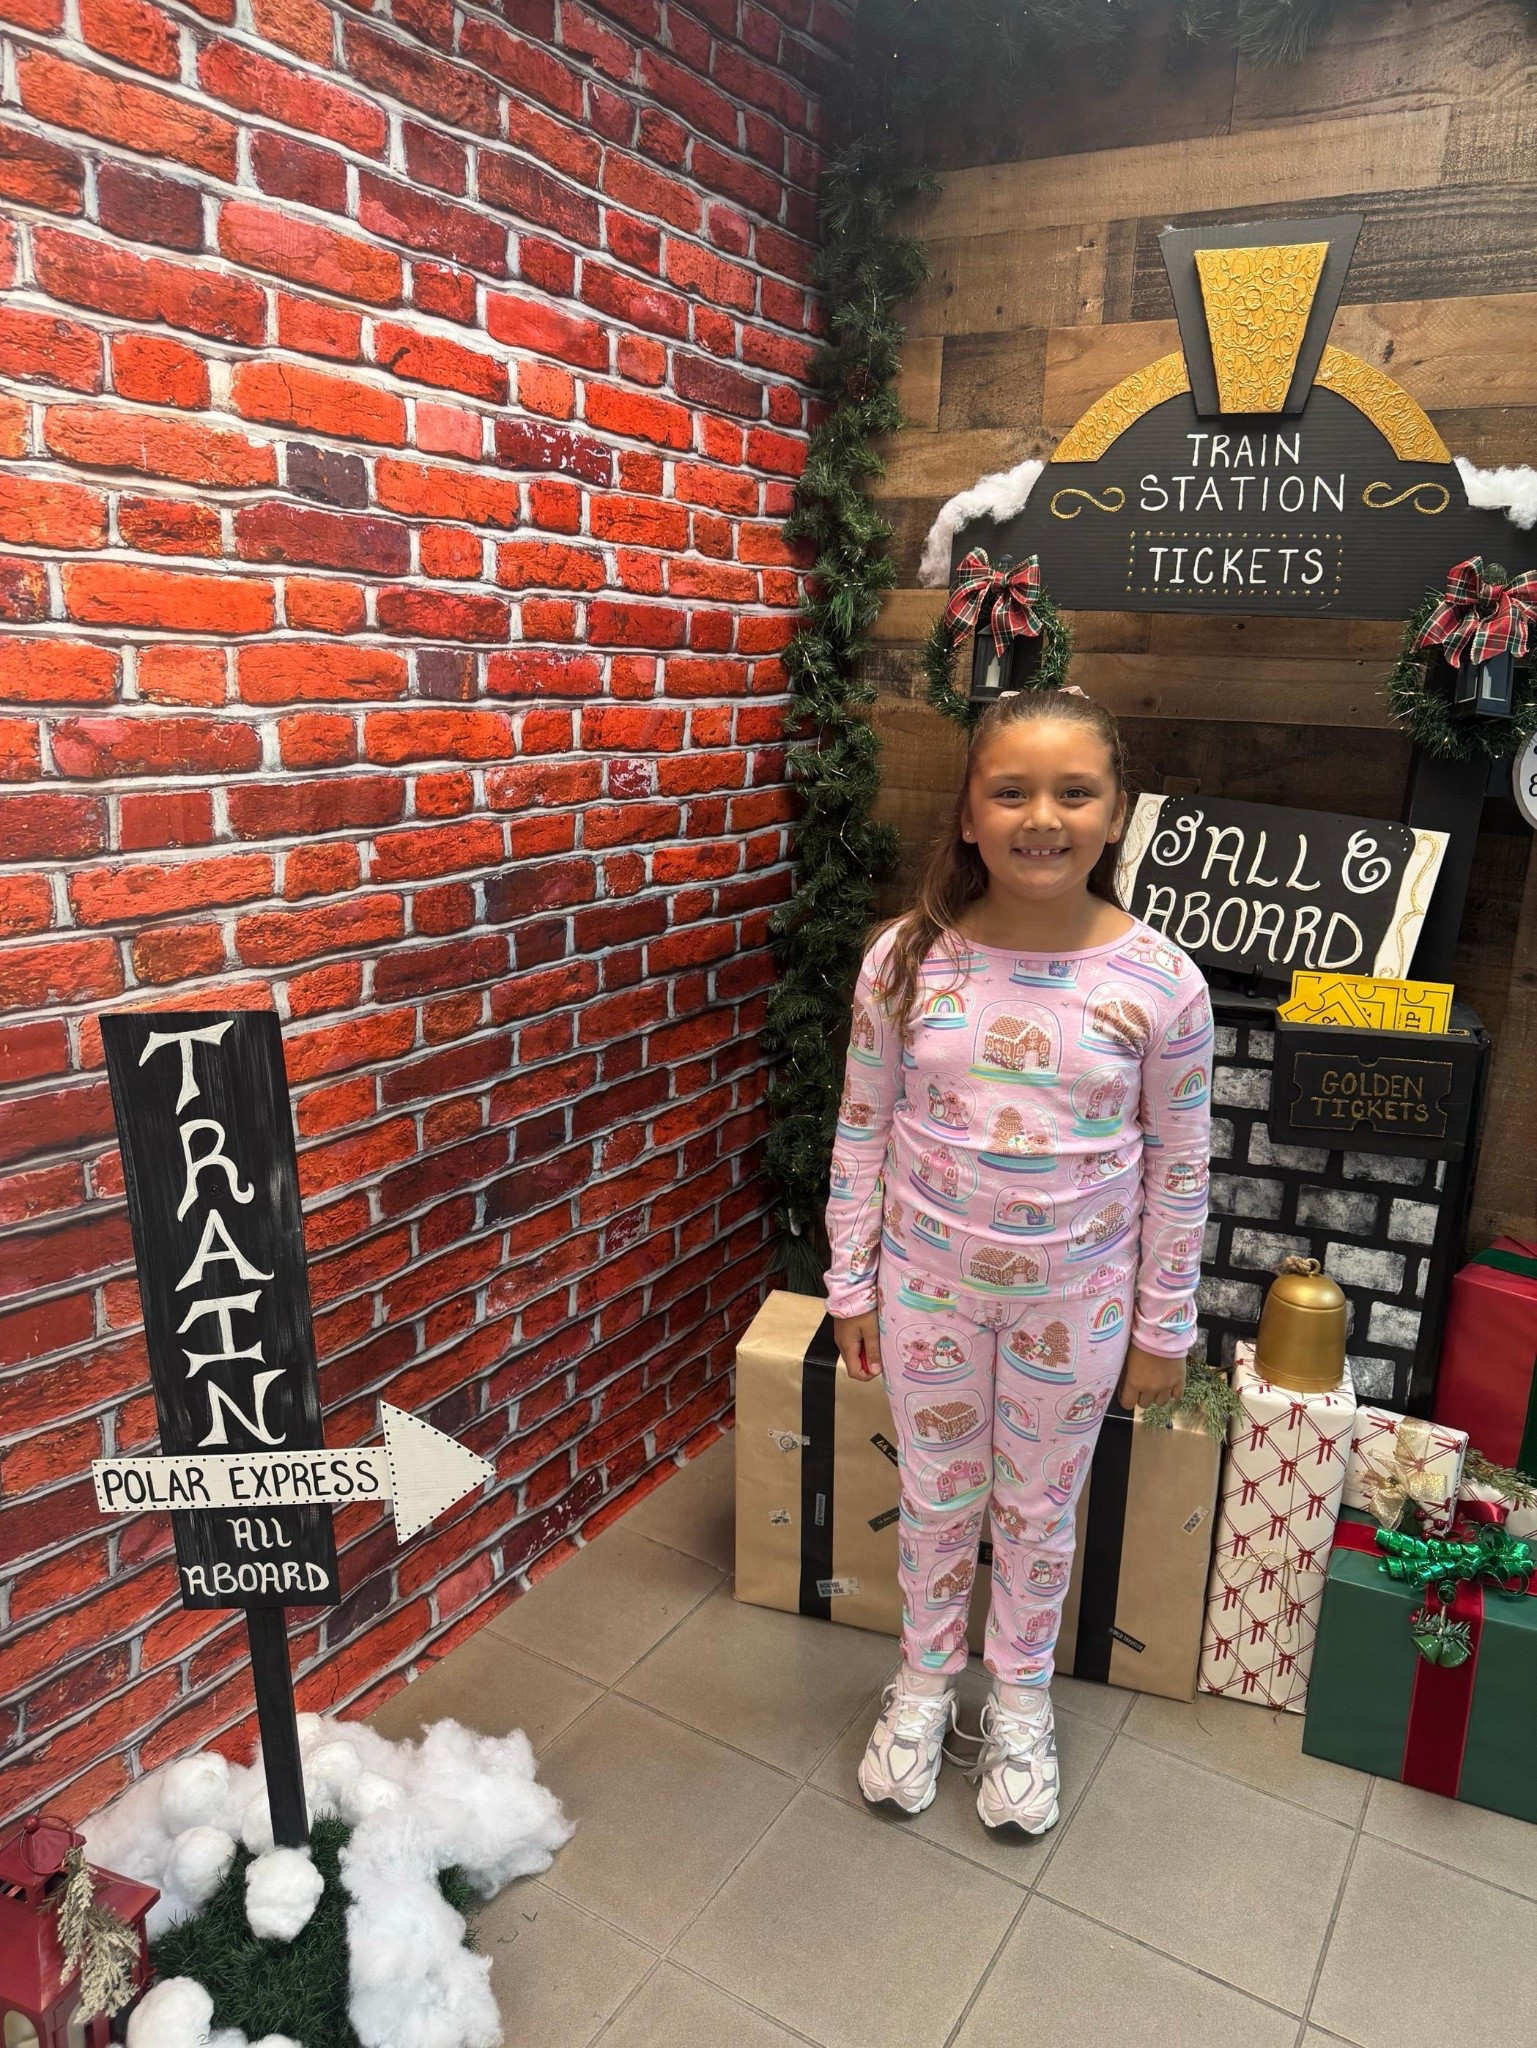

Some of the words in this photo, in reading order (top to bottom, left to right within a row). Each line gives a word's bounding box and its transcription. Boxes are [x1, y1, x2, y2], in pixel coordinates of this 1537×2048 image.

[1187, 433, 1301, 468] TRAIN
[1141, 474, 1345, 512] STATION
[1149, 547, 1323, 585] TICKETS
[1142, 884, 1363, 969] ABOARD
[1321, 1070, 1423, 1099] GOLDEN
[1311, 1096, 1429, 1122] TICKETS
[139, 1020, 286, 1447] TRAIN
[102, 1468, 211, 1506] POLAR
[229, 1460, 379, 1500] EXPRESS
[227, 1518, 292, 1551] ALL
[182, 1562, 330, 1596] ABOARD
